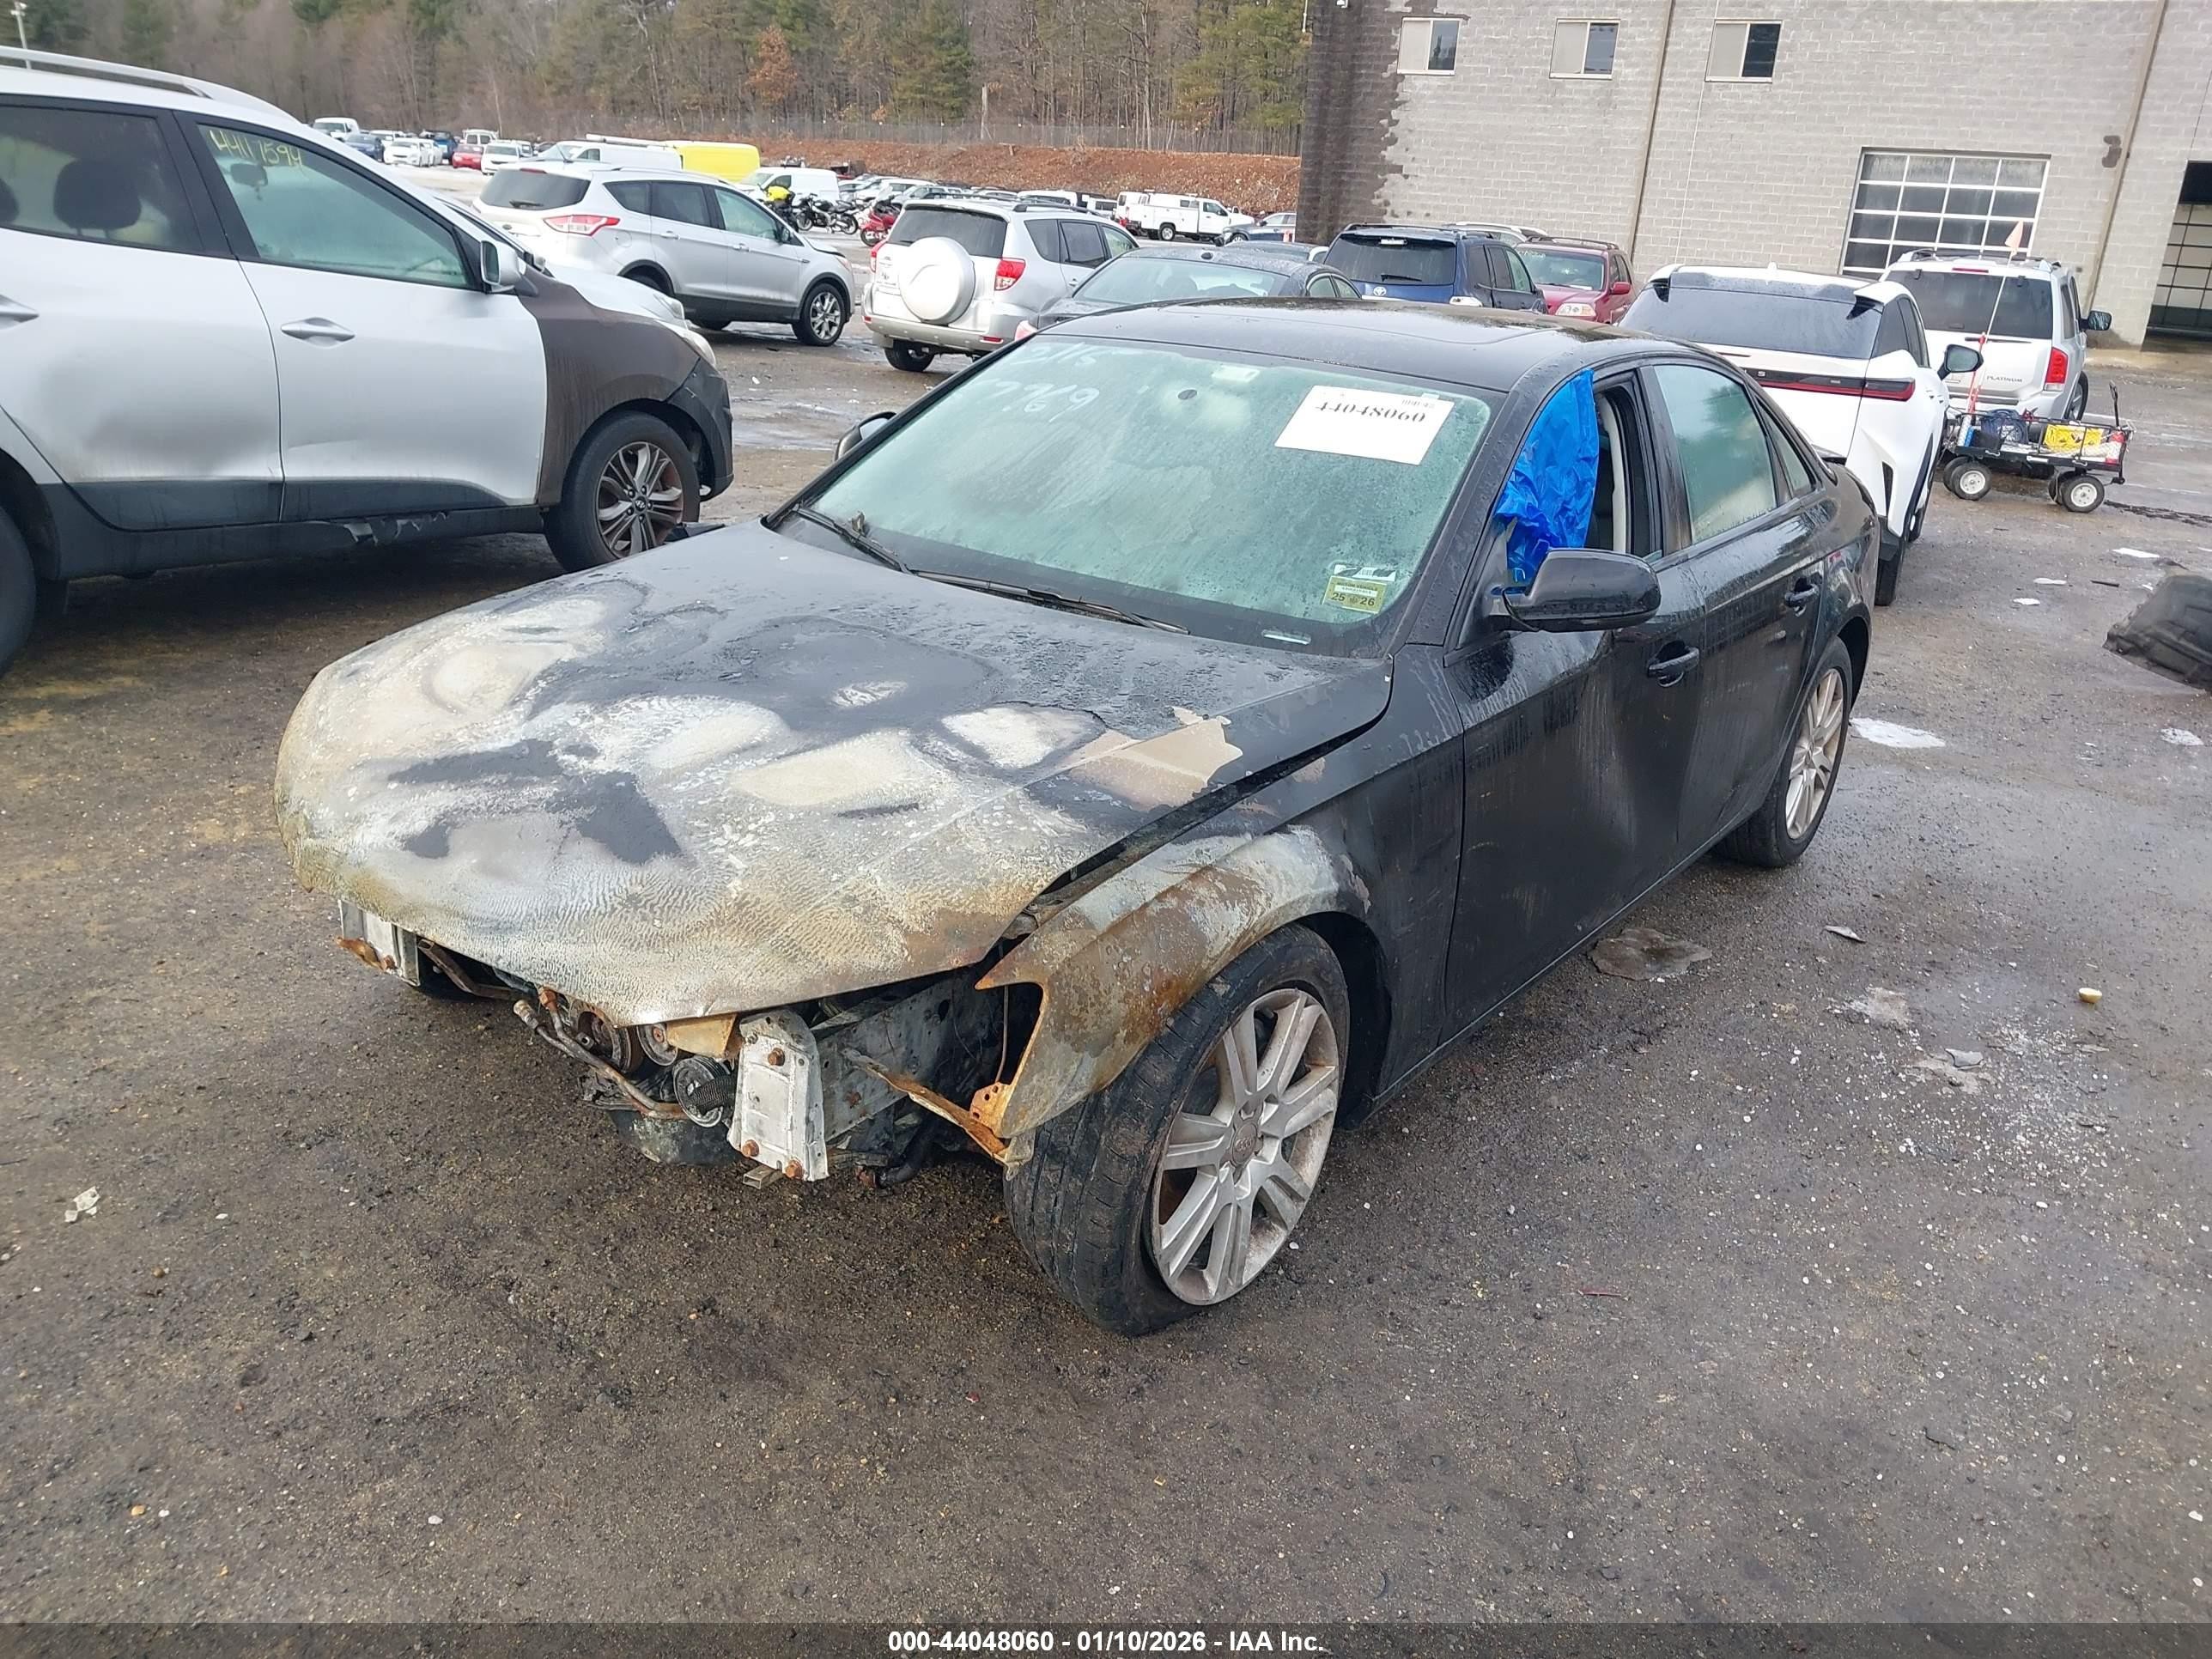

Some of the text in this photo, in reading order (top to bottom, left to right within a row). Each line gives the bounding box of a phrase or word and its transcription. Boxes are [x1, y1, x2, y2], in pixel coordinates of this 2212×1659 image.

[1315, 401, 1426, 422] 44048060
[1332, 592, 1376, 606] 25 26
